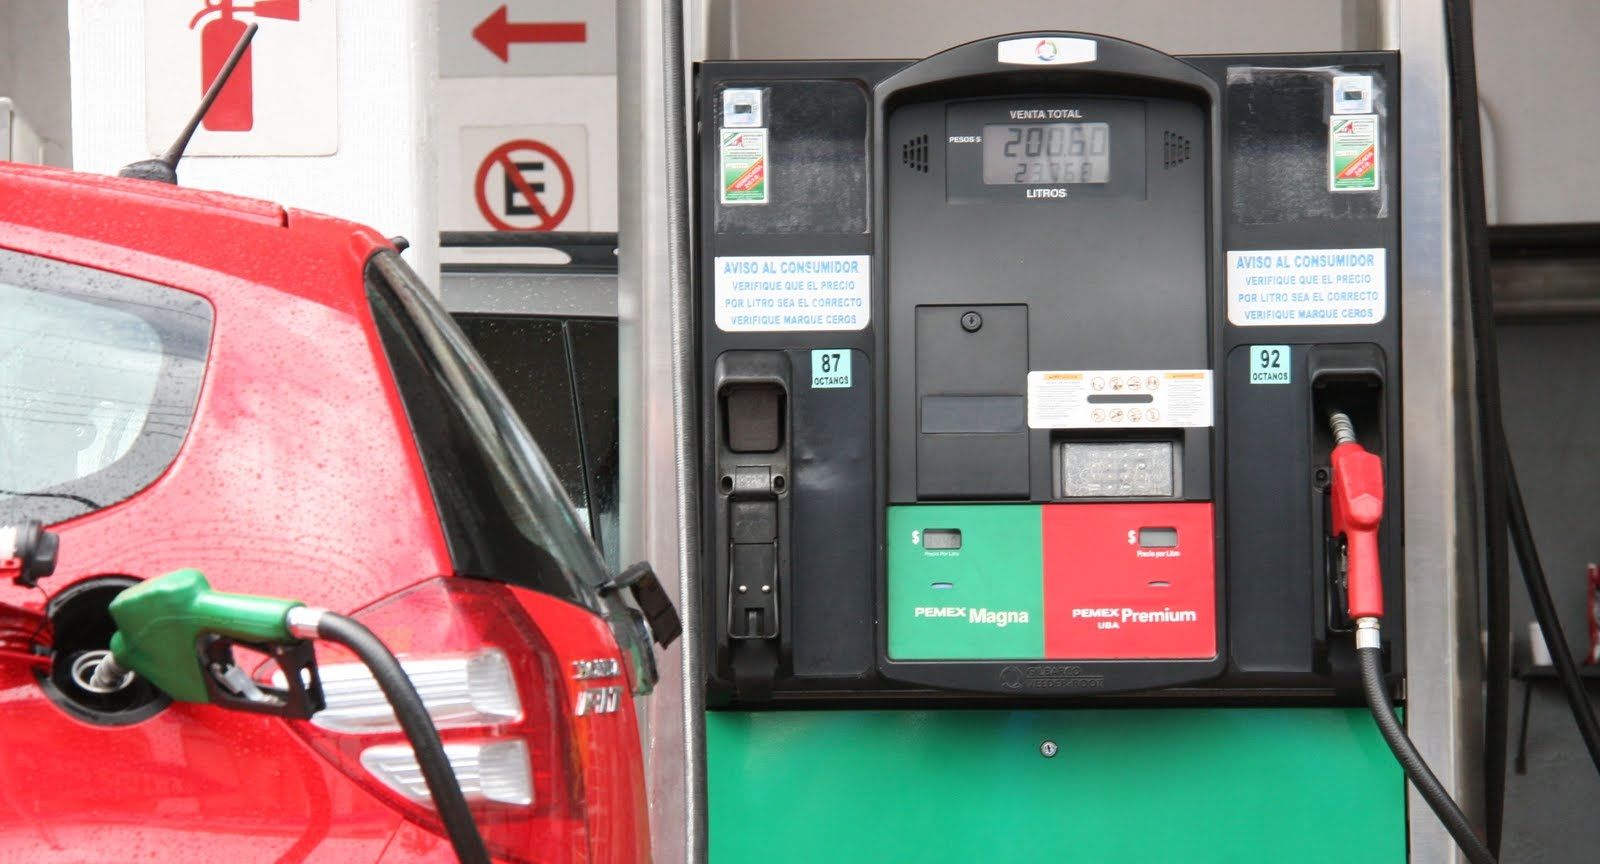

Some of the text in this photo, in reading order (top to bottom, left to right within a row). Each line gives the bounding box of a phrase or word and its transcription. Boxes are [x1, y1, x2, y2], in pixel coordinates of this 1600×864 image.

[1010, 109, 1082, 119] VENTA TOTAL
[505, 162, 545, 215] E
[1026, 188, 1067, 198] LITROS
[724, 260, 859, 274] AVISO AL CONSUMIDOR
[1236, 254, 1375, 269] AVISO AL CONSUMIDOR
[1246, 274, 1371, 285] VERIFIQUE QUE EL PRECIO
[732, 281, 855, 291] VERIFIQUE QUE EL PRECIO
[1238, 291, 1378, 302] POR LITRO SEA EL CORRECTO
[725, 297, 862, 308] POR LITRO SEA EL CORRECTO
[731, 314, 857, 325] VERIFIQUE MARQUE CEROS
[1244, 309, 1373, 320] VERIFIQUE MARQUE CEROS
[822, 354, 840, 373] 87
[1261, 350, 1280, 368] 92
[814, 376, 849, 385] OCTANOS
[1253, 372, 1288, 381] OCTANOS
[912, 530, 920, 545] $
[1128, 530, 1136, 545] $
[915, 607, 1029, 627] PEMEX Magna
[1072, 607, 1196, 623] PEMEX Premium
